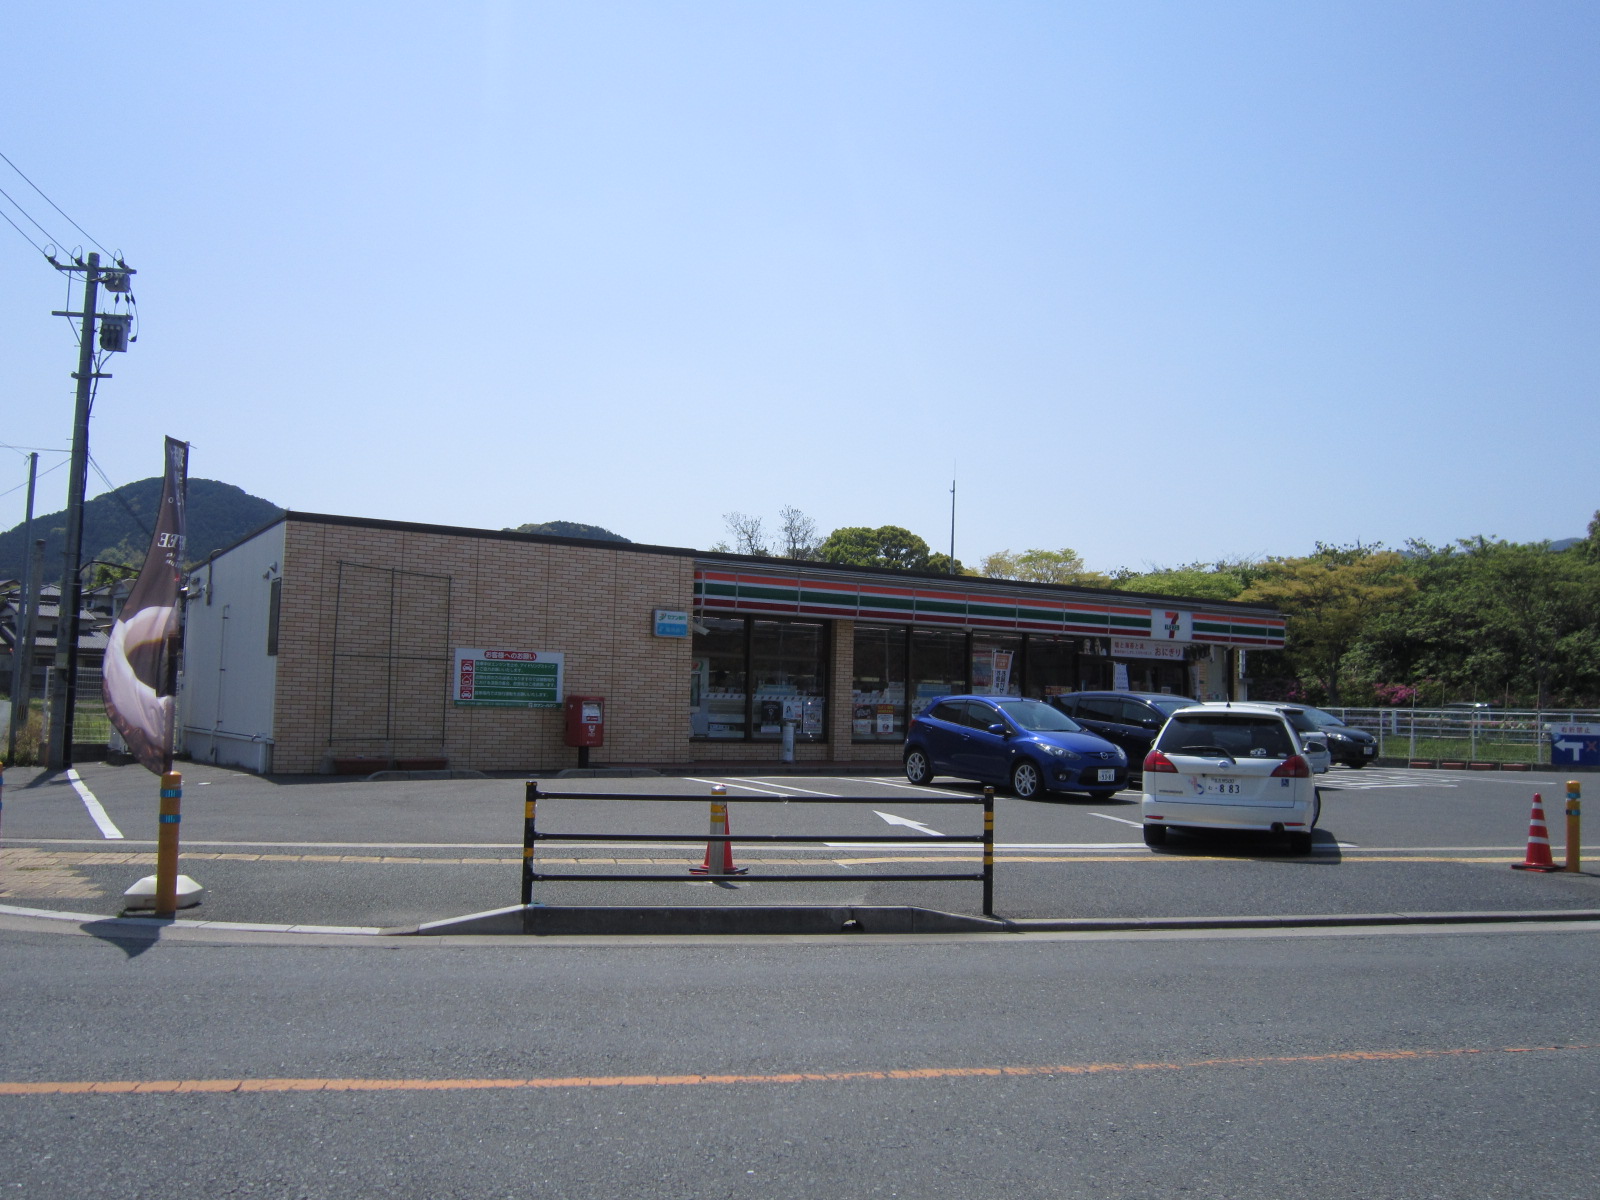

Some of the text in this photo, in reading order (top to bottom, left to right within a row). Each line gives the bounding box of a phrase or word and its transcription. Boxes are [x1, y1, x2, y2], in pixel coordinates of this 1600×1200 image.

[485, 651, 536, 660] お客様へのお願い
[1154, 647, 1181, 657] おにぎり
